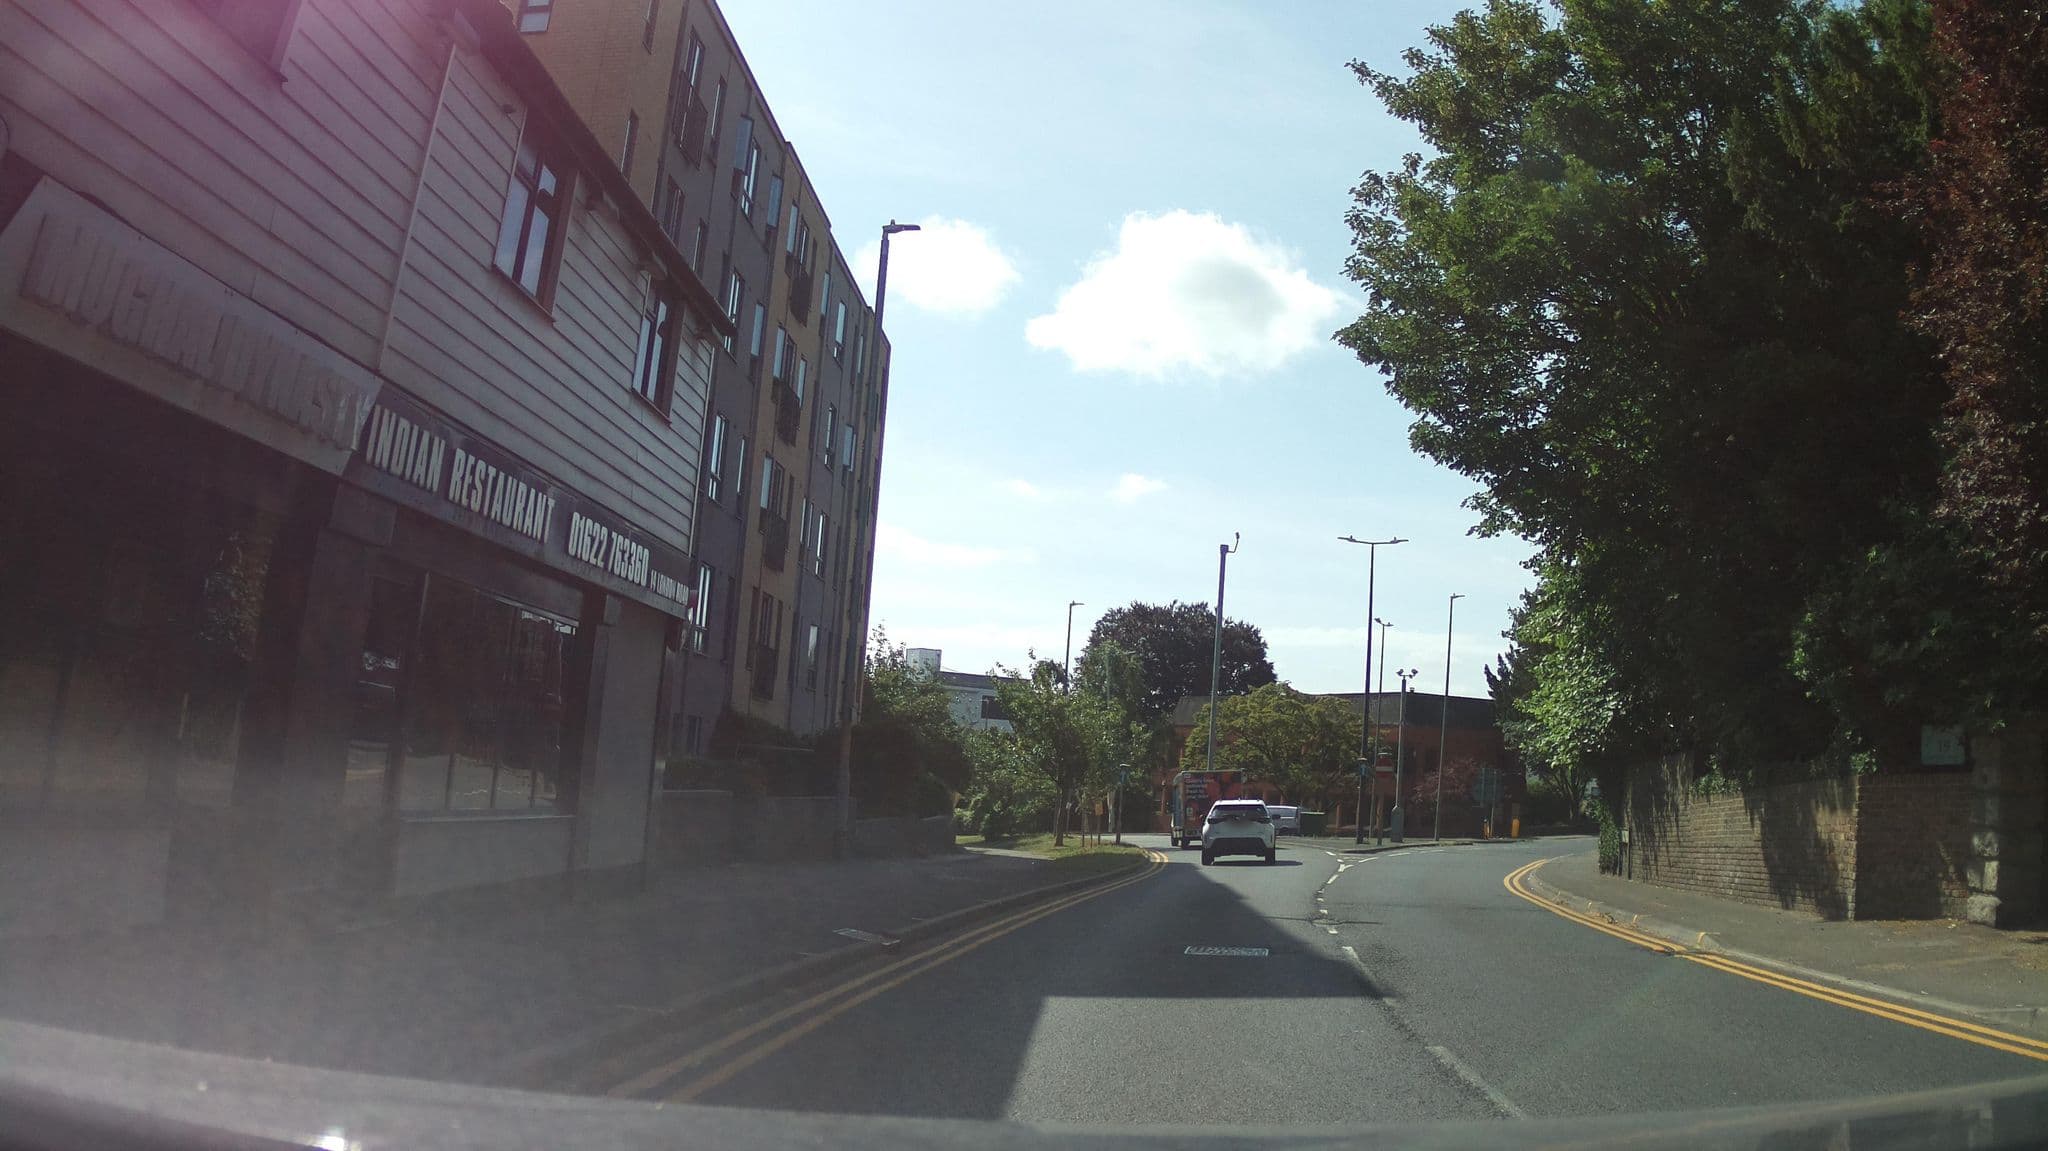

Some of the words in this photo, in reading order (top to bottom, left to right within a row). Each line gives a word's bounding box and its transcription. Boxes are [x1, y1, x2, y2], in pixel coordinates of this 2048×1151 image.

[366, 404, 446, 492] INDIAN
[449, 448, 555, 543] RESTAURANT
[568, 511, 608, 568] 01622
[608, 531, 650, 587] 763360
